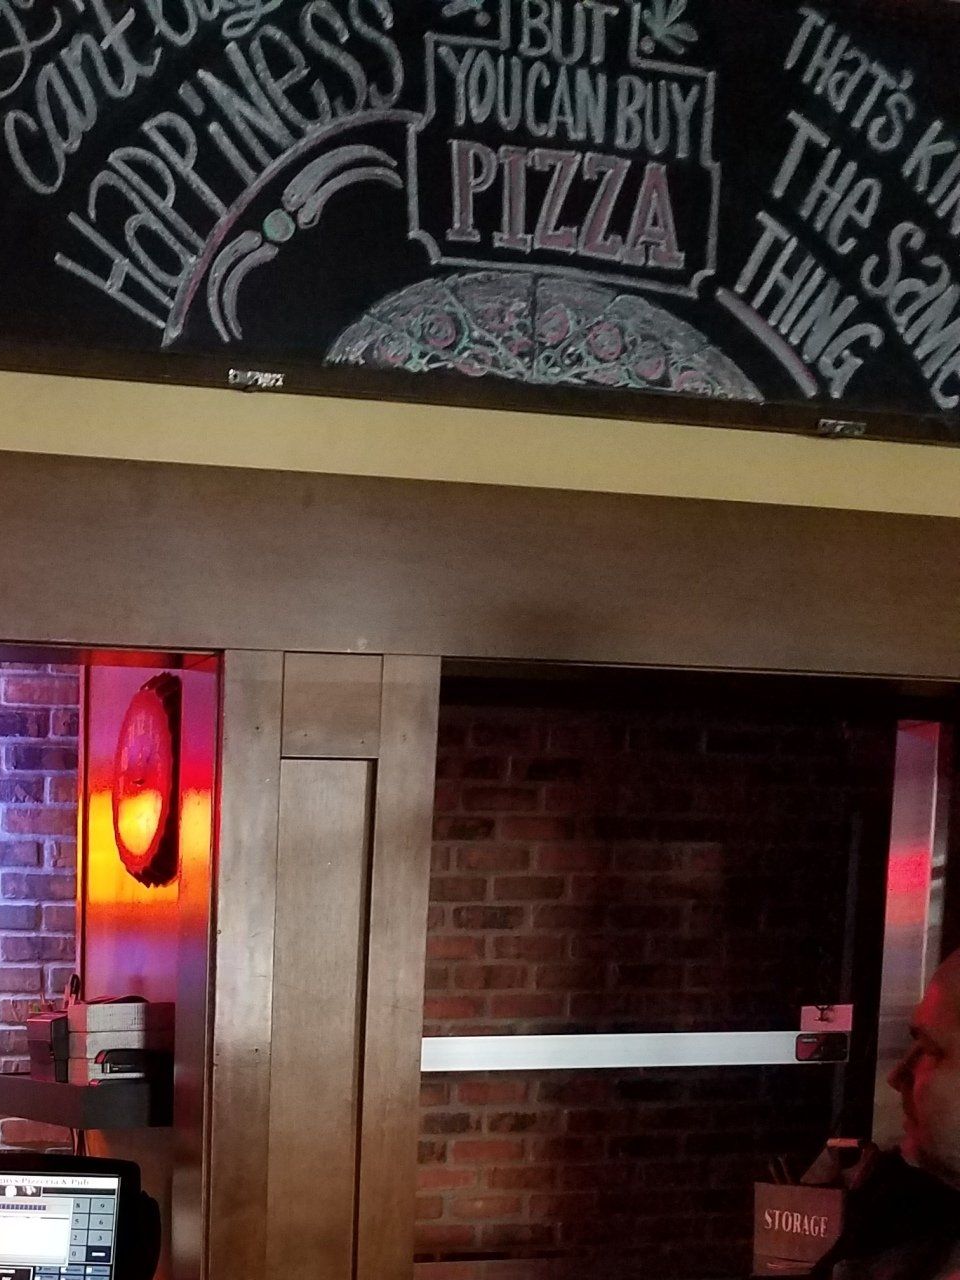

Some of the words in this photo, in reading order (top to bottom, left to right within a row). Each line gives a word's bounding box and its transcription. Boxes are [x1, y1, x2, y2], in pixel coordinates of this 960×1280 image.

[518, 0, 619, 65] BUT
[438, 46, 523, 130] YOU
[526, 60, 608, 143] CAN
[614, 74, 701, 159] BUY
[446, 138, 686, 269] PIZZA
[733, 210, 885, 400] THING
[764, 1209, 828, 1237] STORAGE
